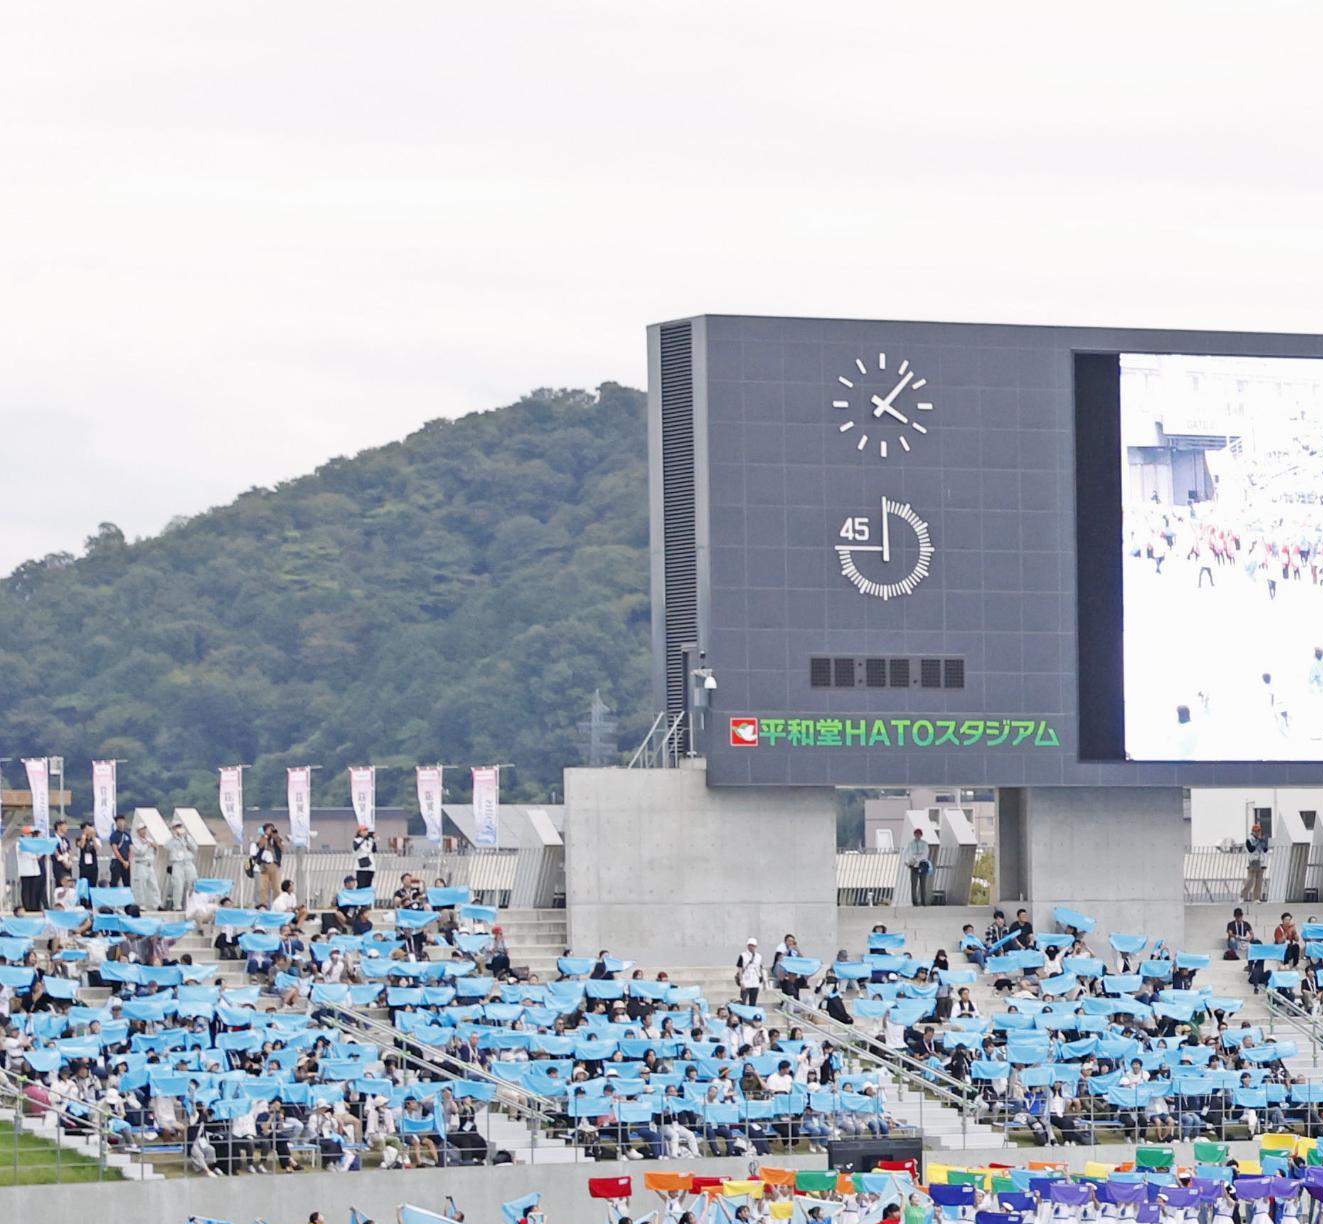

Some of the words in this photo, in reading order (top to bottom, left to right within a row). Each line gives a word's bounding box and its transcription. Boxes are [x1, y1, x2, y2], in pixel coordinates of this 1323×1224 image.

[839, 517, 870, 541] 45
[759, 718, 1060, 747] 平和堂HATOスタジアム
